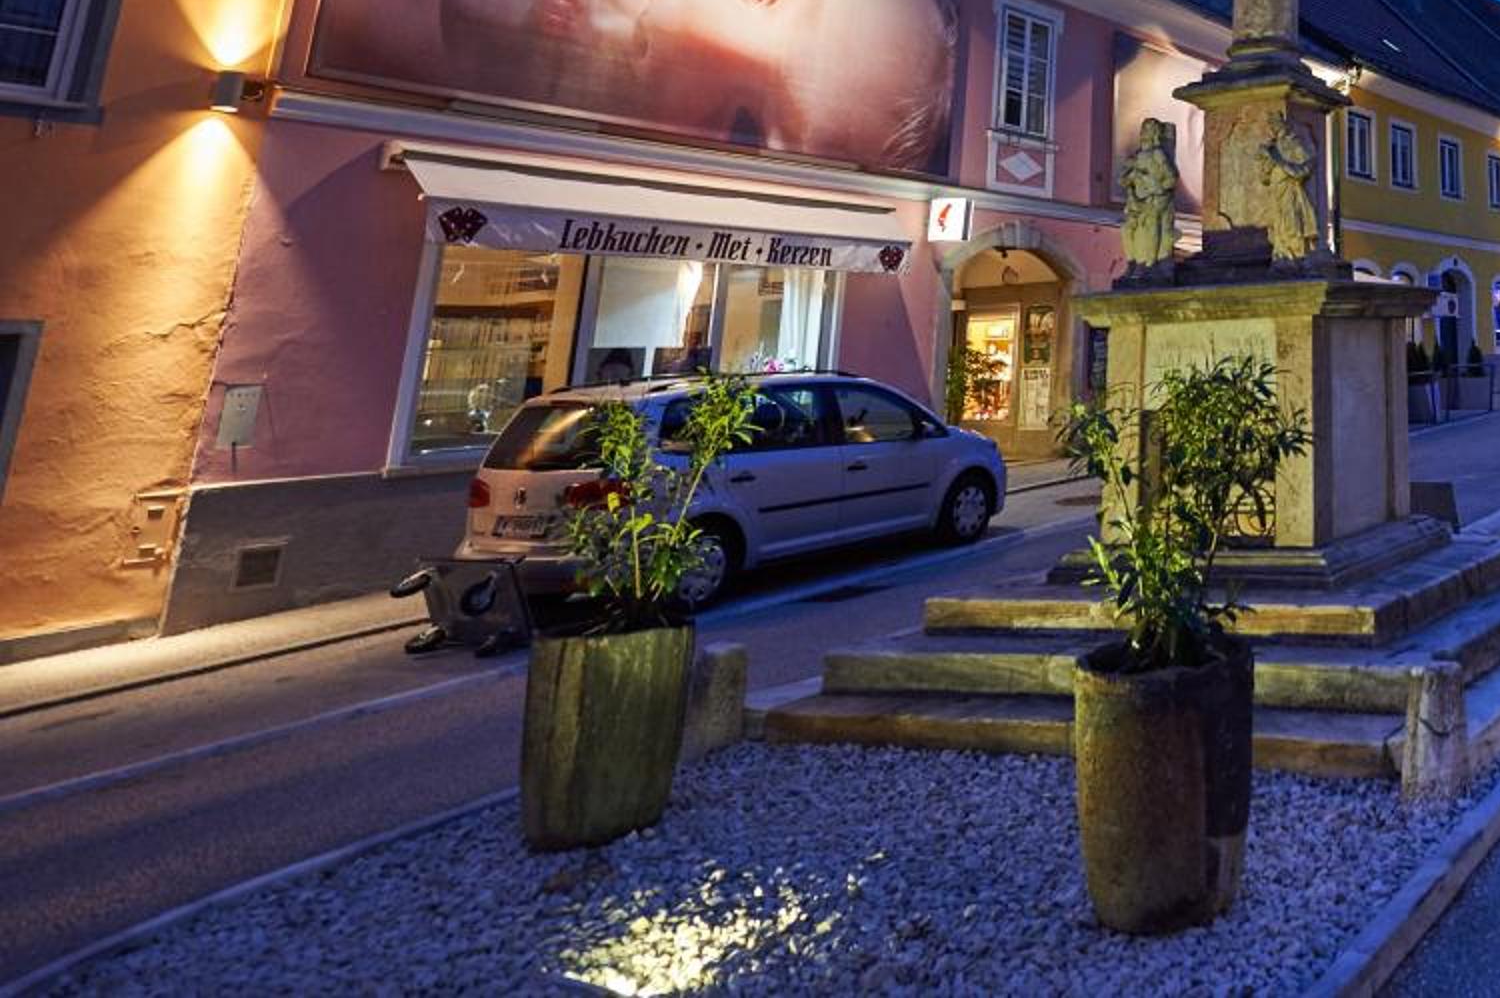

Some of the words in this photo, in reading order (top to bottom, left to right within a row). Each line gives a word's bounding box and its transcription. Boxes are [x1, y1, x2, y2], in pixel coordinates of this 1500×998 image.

[559, 218, 691, 256] Lebkuchen
[706, 231, 751, 260] Met
[766, 237, 832, 266] Kerzen
